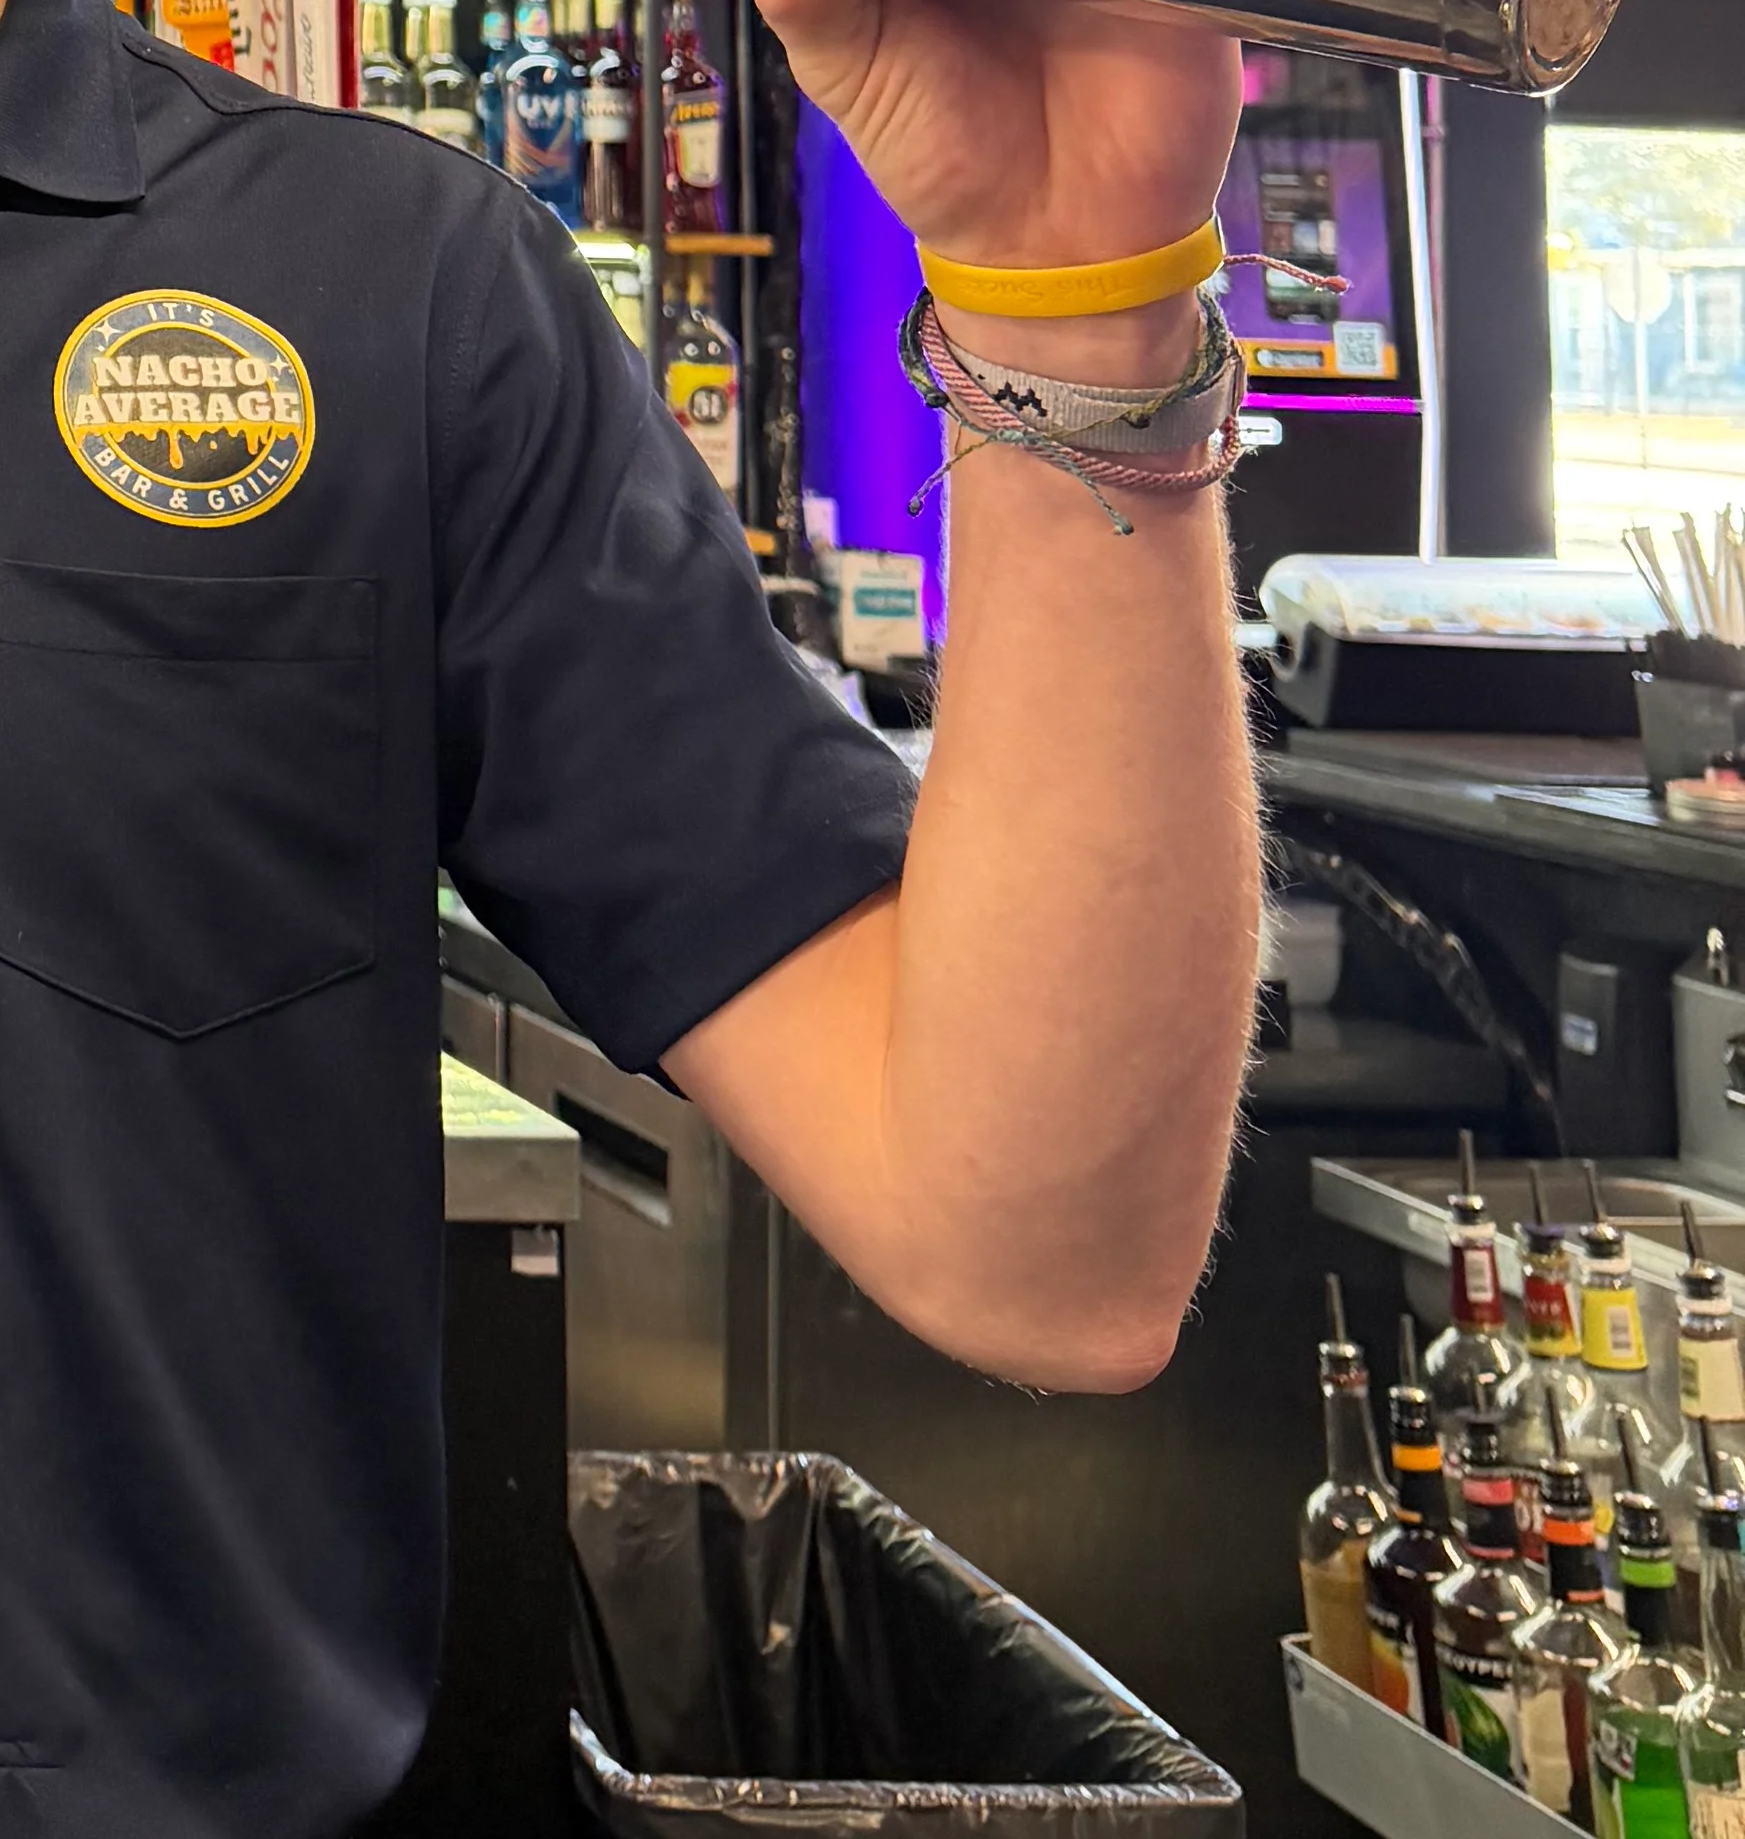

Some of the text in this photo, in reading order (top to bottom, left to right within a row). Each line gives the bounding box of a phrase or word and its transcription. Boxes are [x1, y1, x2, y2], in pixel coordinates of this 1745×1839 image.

[147, 302, 216, 329] IT'S
[93, 354, 268, 388] NACHO
[73, 391, 300, 425] AVERAGE
[94, 447, 289, 510] BAR & GRILL
